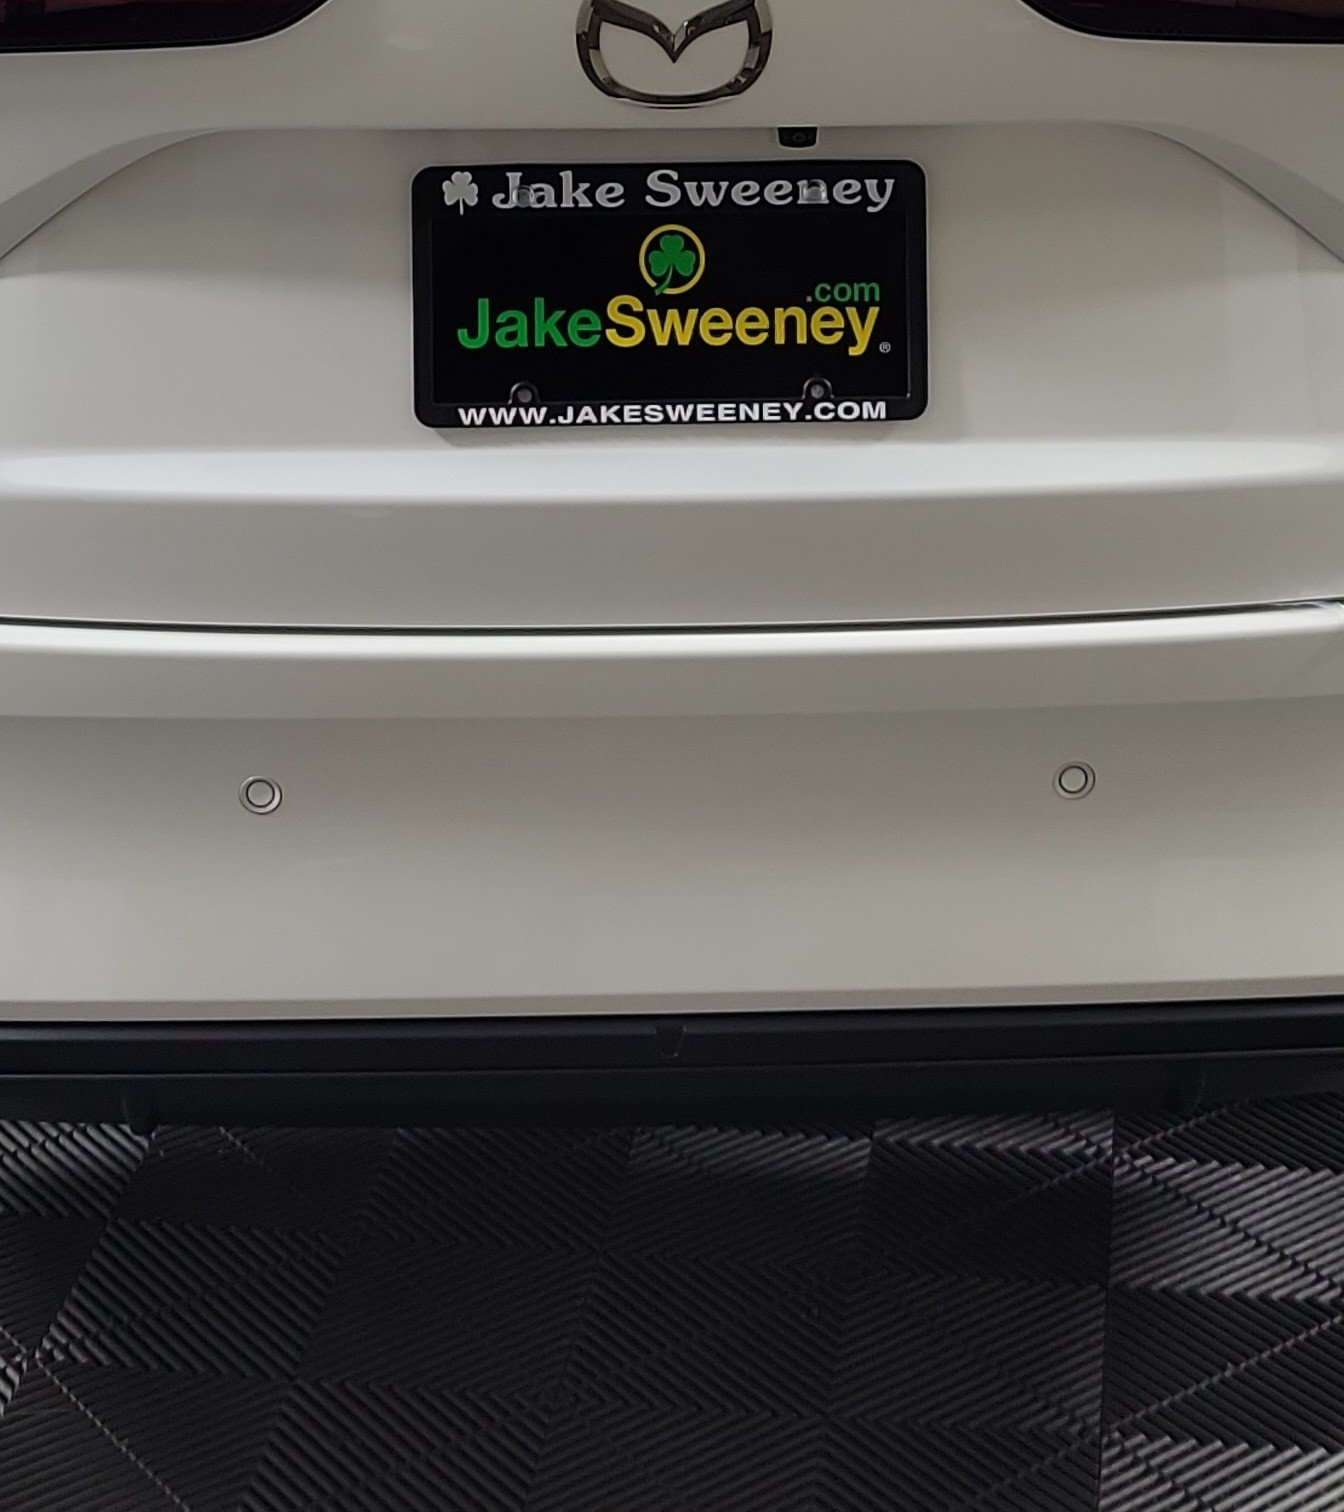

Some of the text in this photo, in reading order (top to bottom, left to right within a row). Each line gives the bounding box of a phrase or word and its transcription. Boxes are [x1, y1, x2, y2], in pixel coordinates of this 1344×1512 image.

[492, 169, 895, 212] Jake Sweeney
[458, 402, 887, 426] WWW.JAKESWEENEY.COM
